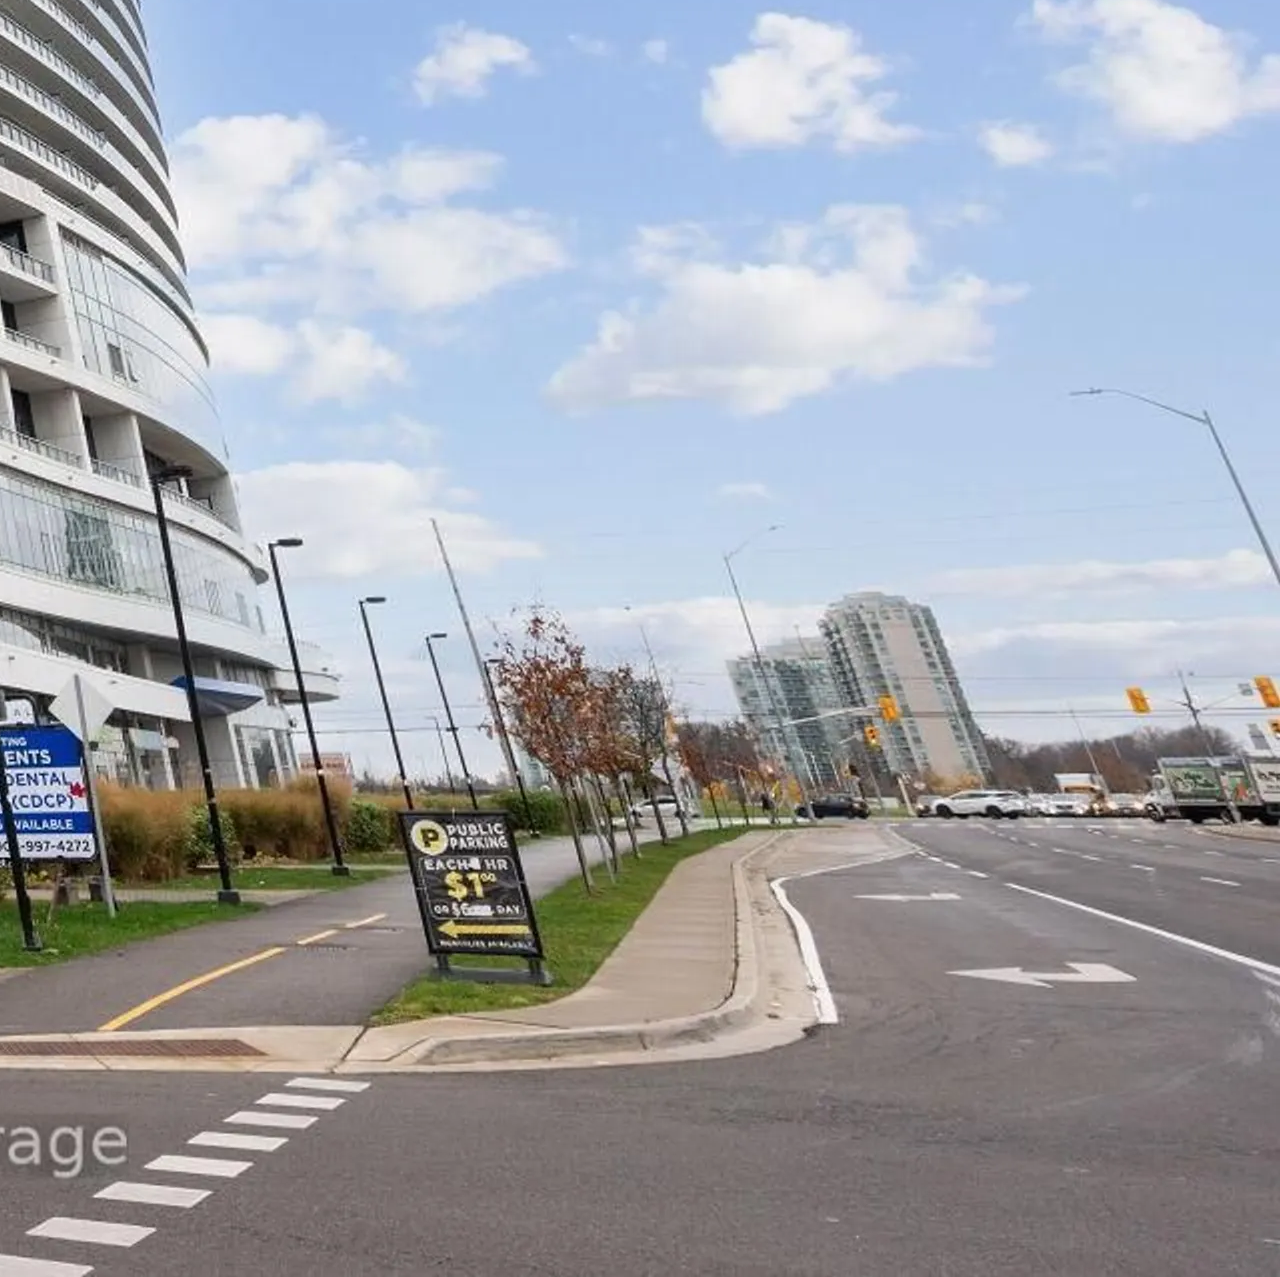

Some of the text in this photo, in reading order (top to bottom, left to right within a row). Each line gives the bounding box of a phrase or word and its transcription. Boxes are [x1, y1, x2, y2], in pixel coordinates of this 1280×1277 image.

[5, 771, 71, 787] DENTAL
[12, 792, 74, 810] (CDCP)
[14, 818, 73, 829] VAILABLE
[446, 823, 505, 836] PUBLIC
[450, 835, 509, 849] PARKING
[424, 858, 509, 871] EACH HR
[496, 905, 520, 915] DAY
